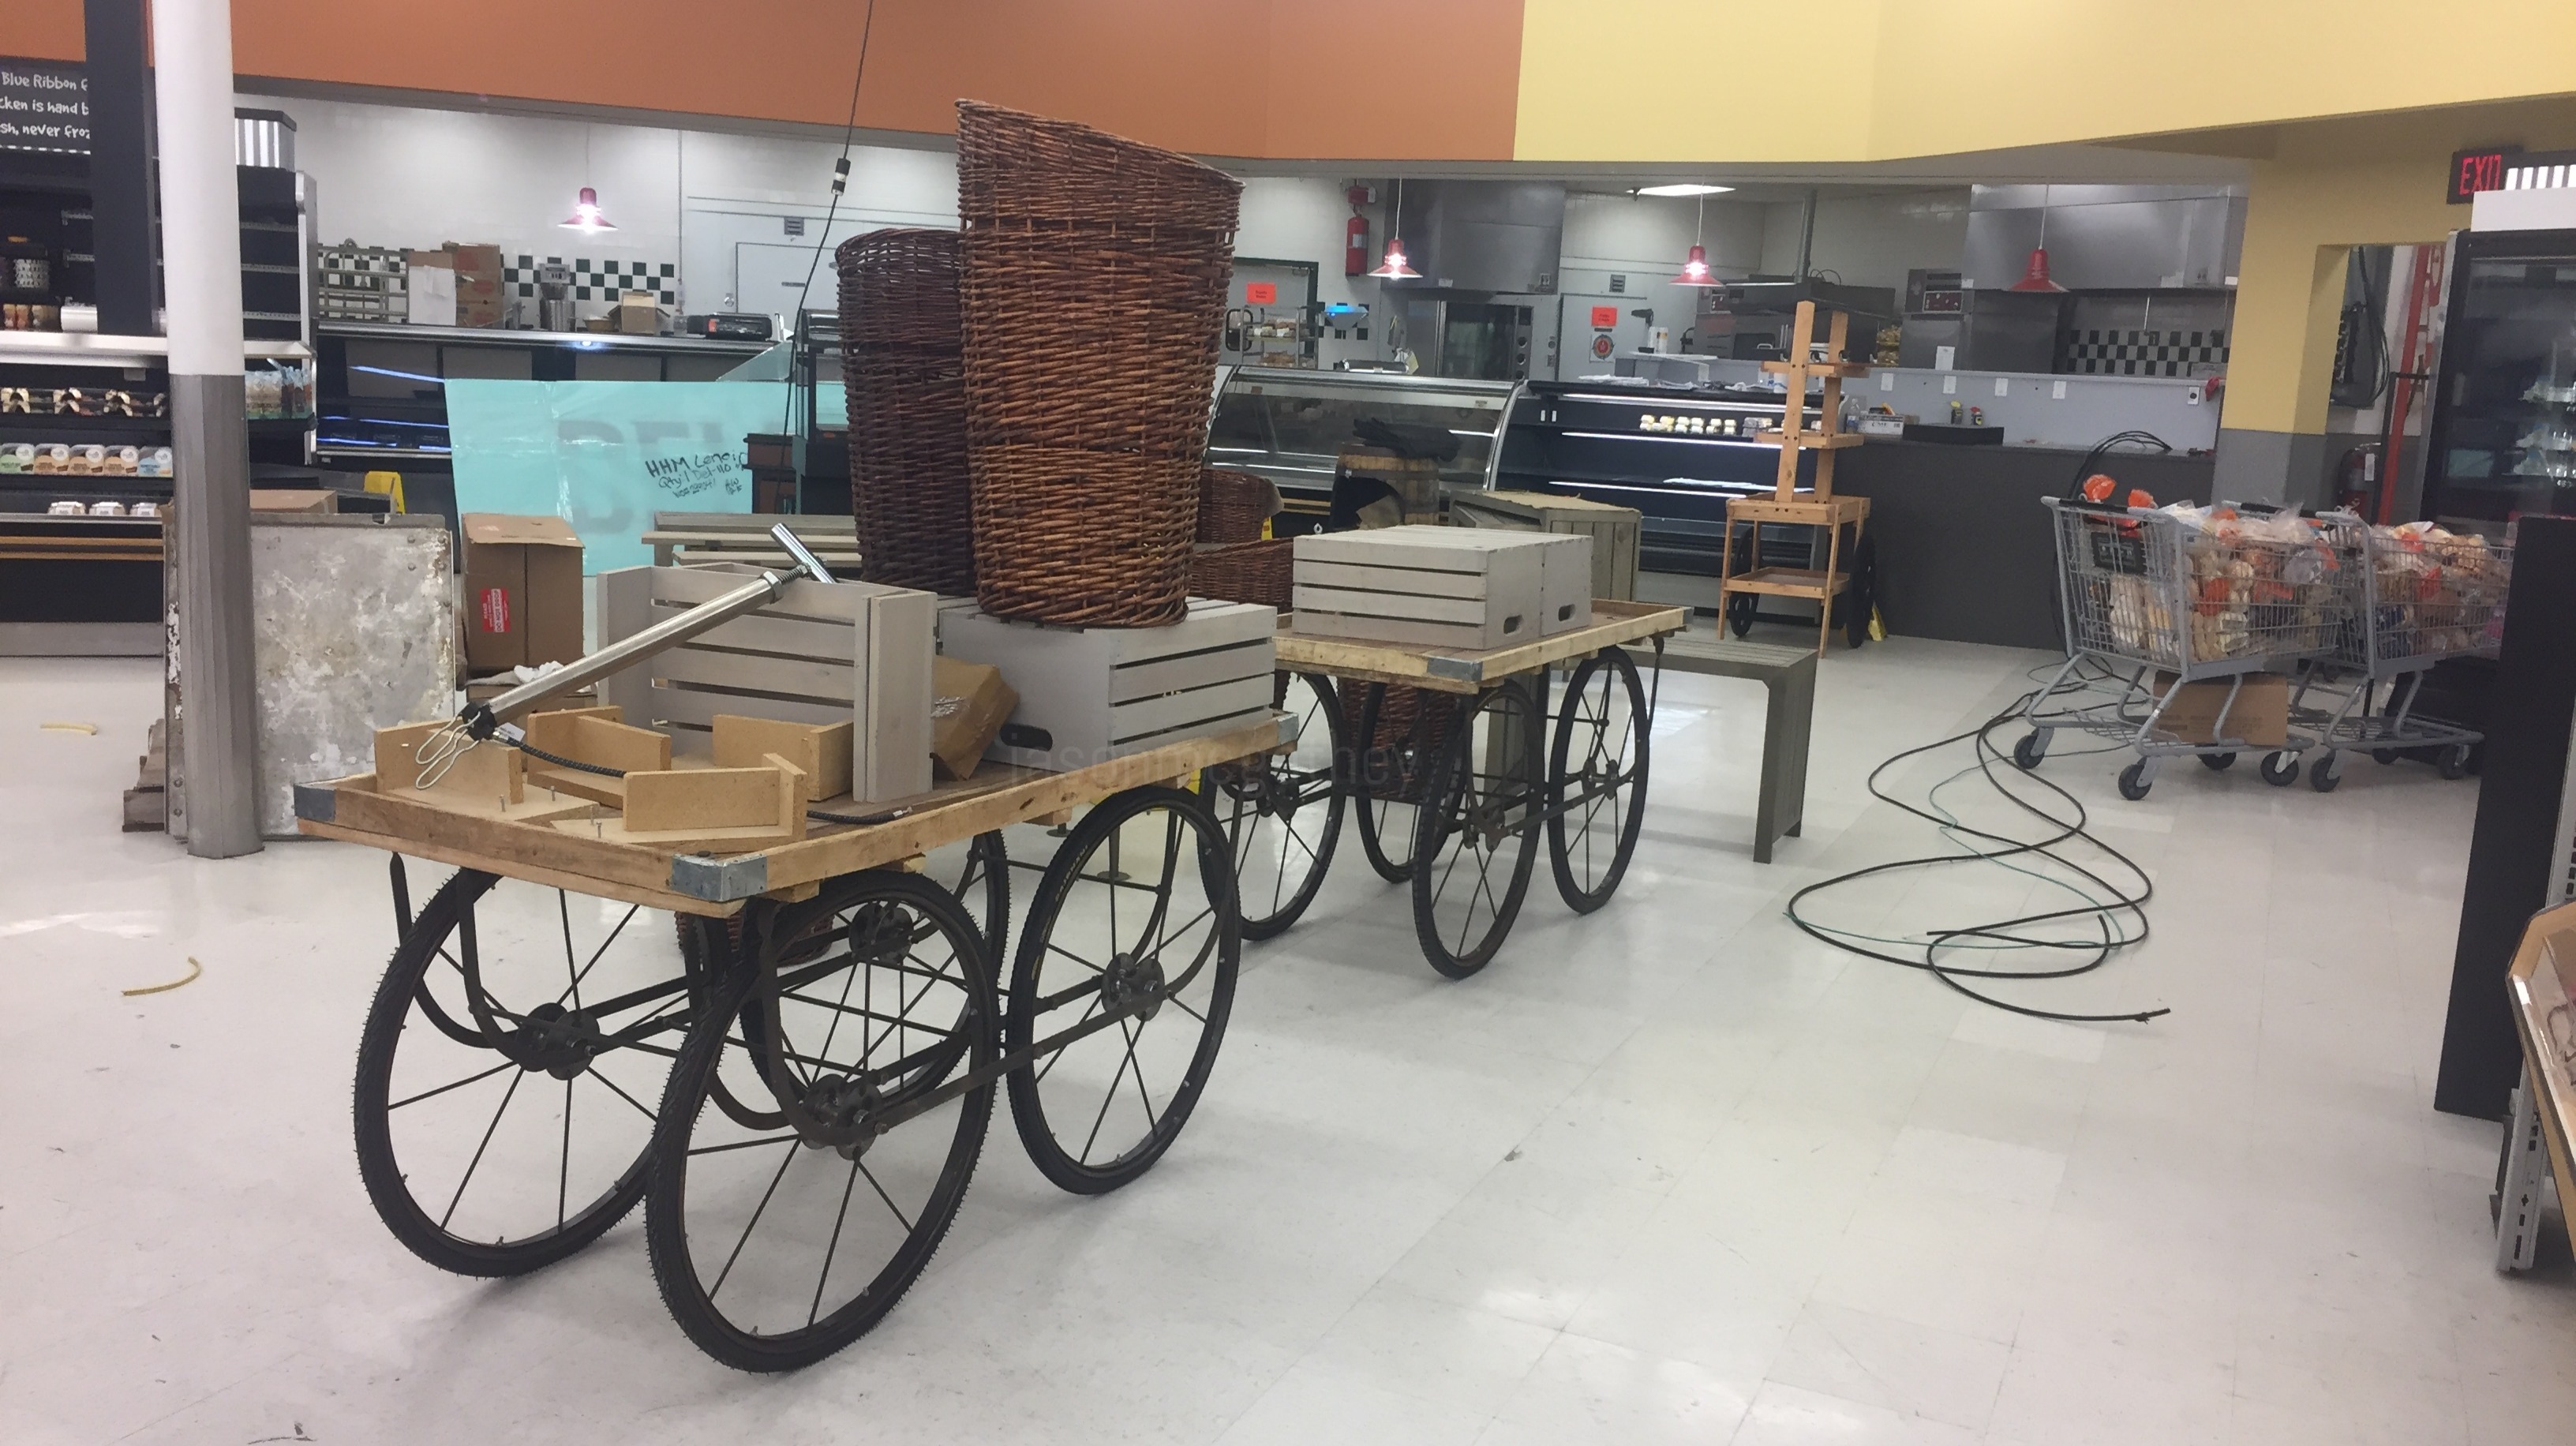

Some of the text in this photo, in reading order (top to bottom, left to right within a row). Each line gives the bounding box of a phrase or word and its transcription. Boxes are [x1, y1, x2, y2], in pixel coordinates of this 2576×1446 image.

[2, 71, 30, 87] Blue
[33, 73, 77, 91] Ribbon
[32, 99, 44, 112] is
[47, 101, 78, 115] hand
[22, 124, 61, 137] never
[2459, 154, 2502, 196] EXIT
[645, 456, 691, 478] HHM
